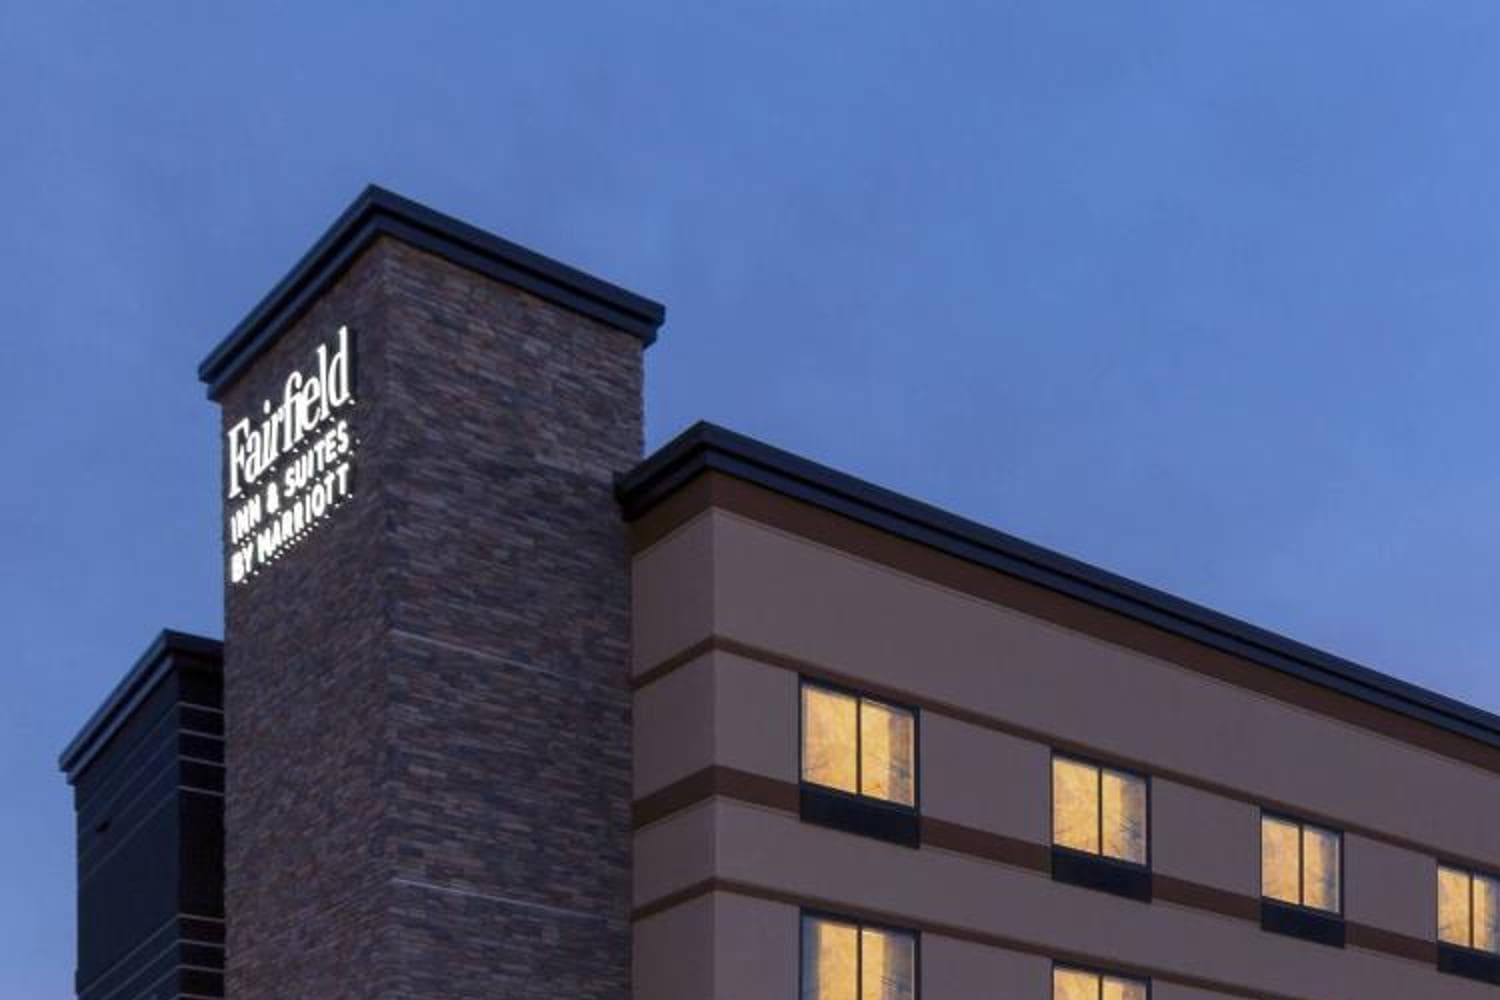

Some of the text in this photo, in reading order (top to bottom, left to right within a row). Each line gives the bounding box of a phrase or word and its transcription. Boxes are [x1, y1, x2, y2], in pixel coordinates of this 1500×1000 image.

[228, 325, 350, 498] Fairfield
[231, 420, 350, 544] INN & SUITES
[231, 463, 350, 583] BY MARRIOTT
